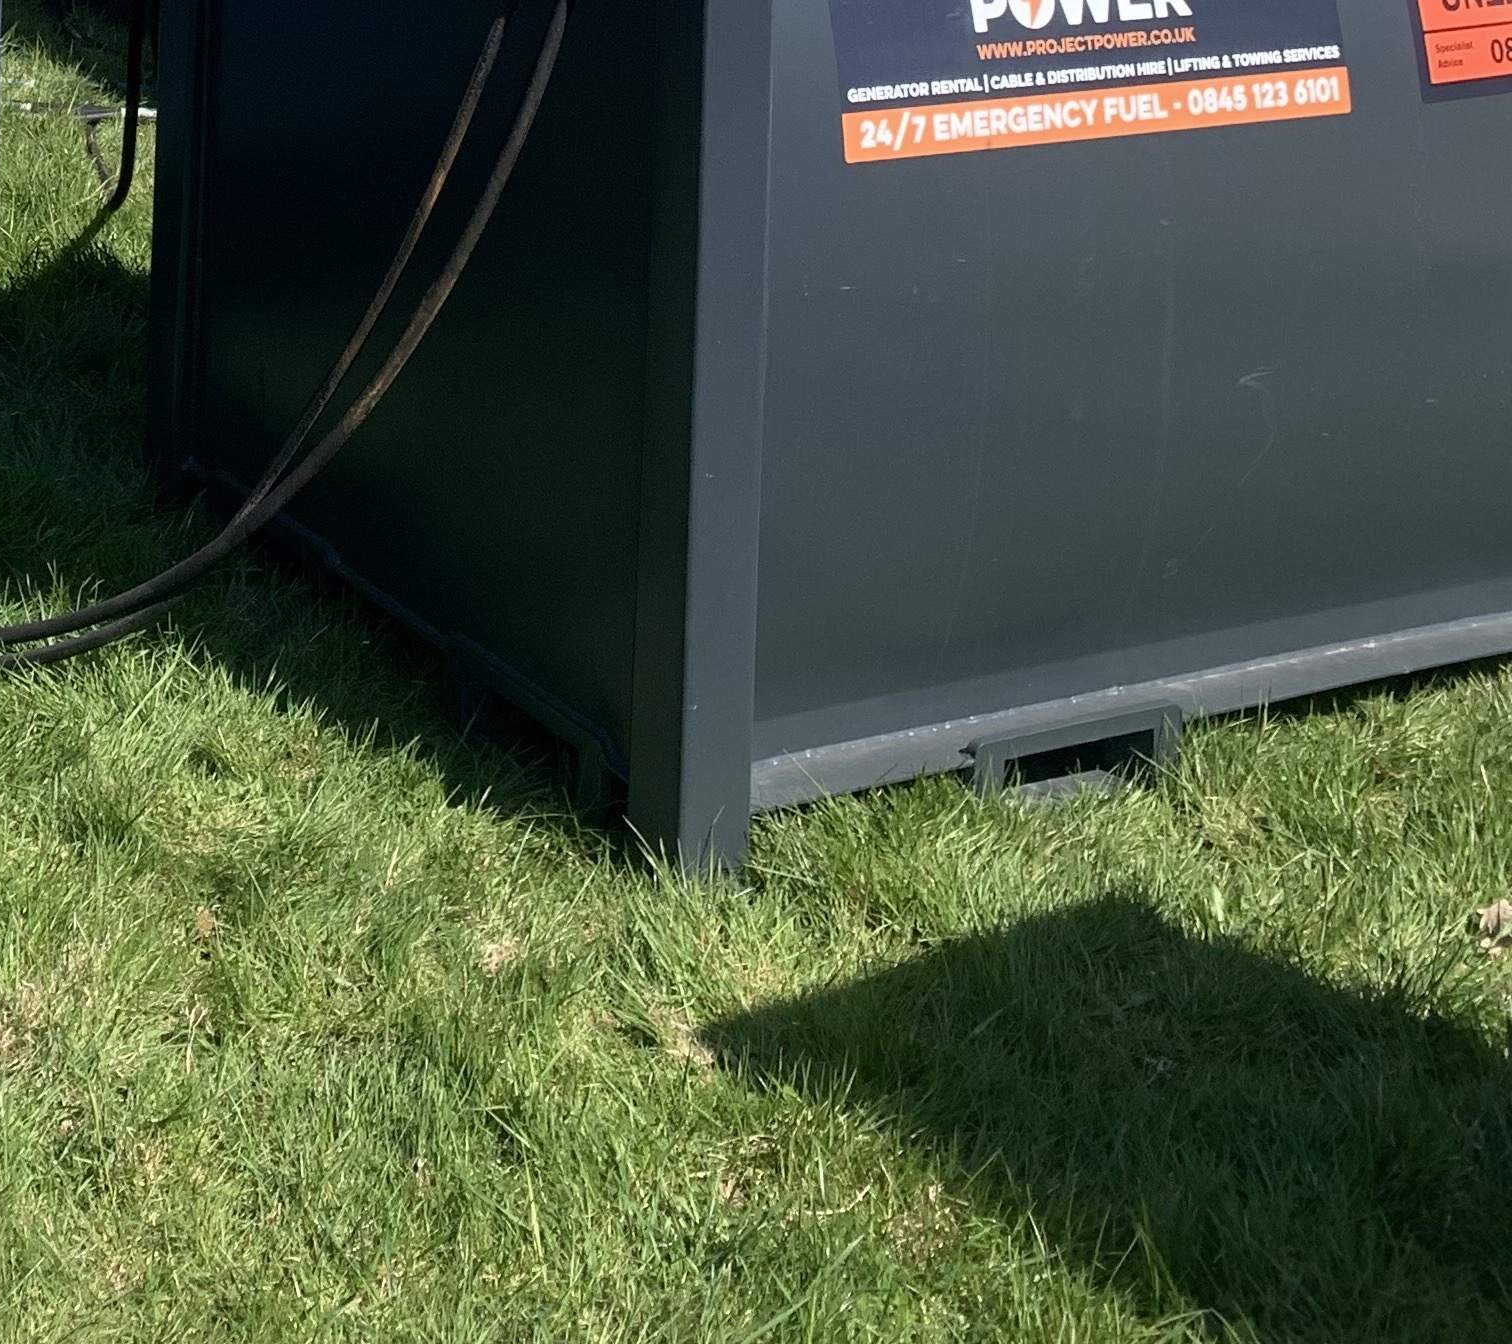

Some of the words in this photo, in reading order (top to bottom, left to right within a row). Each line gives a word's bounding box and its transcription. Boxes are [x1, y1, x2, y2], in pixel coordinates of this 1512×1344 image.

[976, 27, 1197, 60] WWW.PROJECTPOWER.CO.UK
[1435, 40, 1473, 54] Specialist
[847, 82, 930, 103] GENERATOR
[931, 77, 983, 95] RENTAL
[990, 72, 1034, 90] CABLE
[1035, 72, 1046, 86] &
[1047, 63, 1136, 85] DISTRIBUTION
[1137, 60, 1166, 76] HIRE
[1174, 56, 1220, 73] LIFTING
[1221, 55, 1232, 69] &
[1232, 50, 1282, 67] TOWING
[1282, 45, 1340, 63] SERVICES
[1438, 59, 1464, 69] Advice
[860, 112, 927, 152] 24/7
[933, 99, 1098, 142] EMERGENCY
[1103, 93, 1168, 124] FUEL
[1188, 84, 1248, 116] 0845
[1253, 80, 1288, 110] 123
[1294, 76, 1341, 105] 6101
